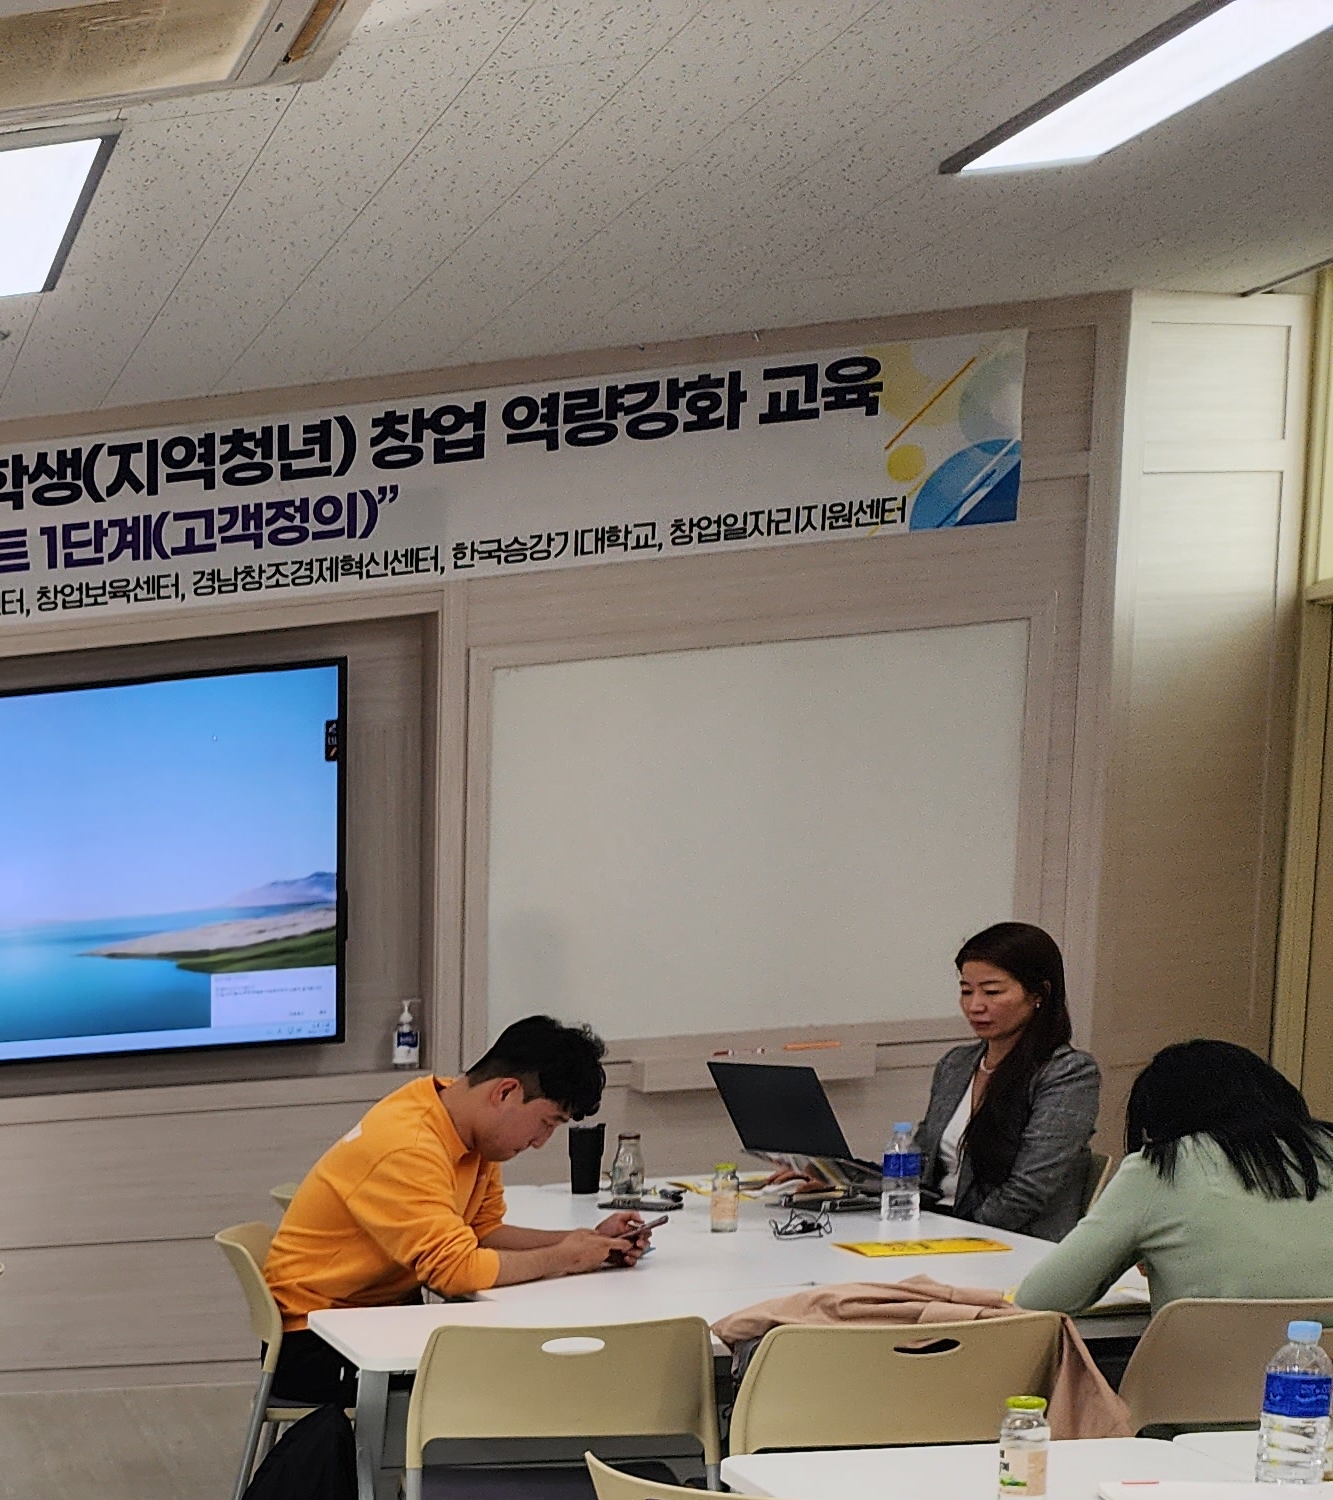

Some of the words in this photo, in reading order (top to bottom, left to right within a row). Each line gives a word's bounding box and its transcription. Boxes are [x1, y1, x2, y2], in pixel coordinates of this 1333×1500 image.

[369, 400, 487, 471] 창업
[501, 370, 748, 452] 역량강화
[758, 355, 884, 425] 교육
[36, 571, 186, 612] 창업보육센터,
[192, 544, 446, 597] 경남창조경제혁신센터,
[451, 521, 664, 570] 한국승강기대학교,
[669, 495, 906, 546] 창업일자리지원센터
